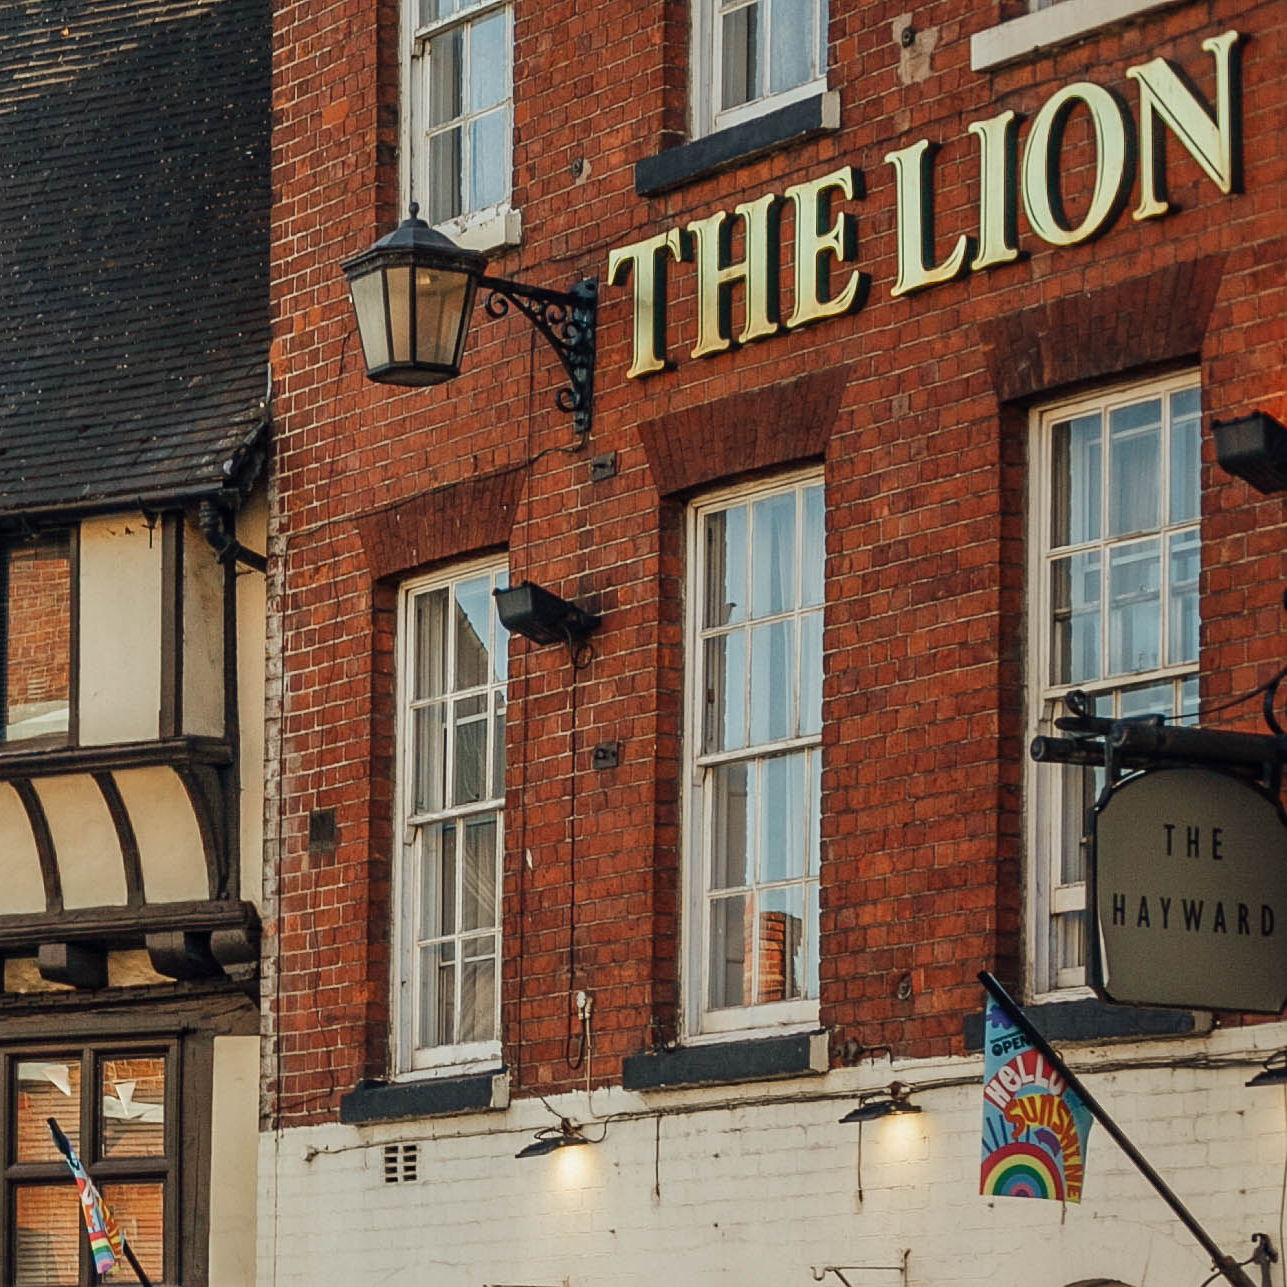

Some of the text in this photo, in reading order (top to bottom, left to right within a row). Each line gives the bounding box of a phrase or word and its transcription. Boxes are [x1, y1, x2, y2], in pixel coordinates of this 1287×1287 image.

[608, 30, 1239, 380] THE LION
[1164, 824, 1223, 860] THE
[1113, 893, 1275, 937] HAYWARD
